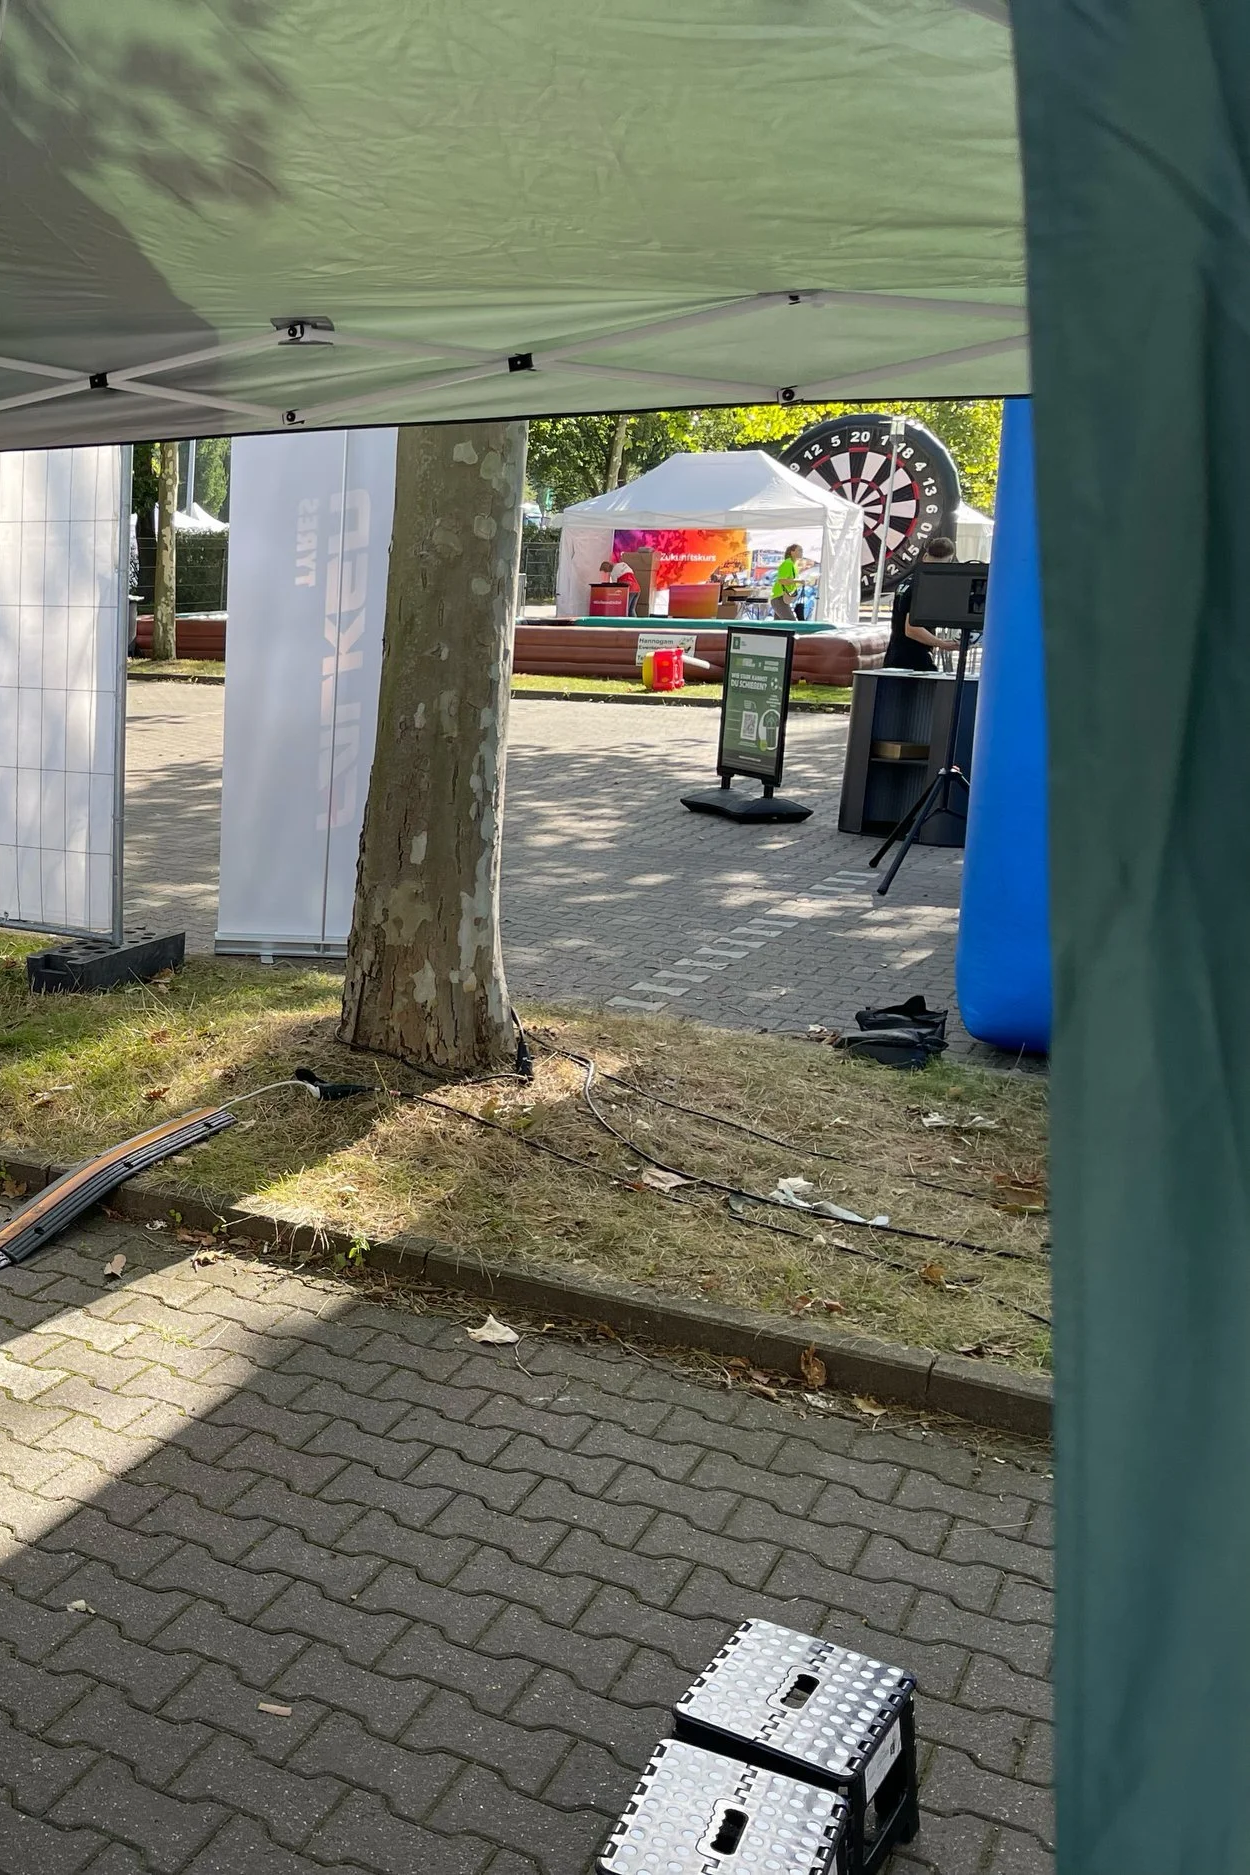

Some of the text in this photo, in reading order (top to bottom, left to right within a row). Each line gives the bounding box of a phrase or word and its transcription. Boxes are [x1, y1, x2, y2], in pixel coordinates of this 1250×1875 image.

[830, 435, 841, 447] 5
[850, 431, 871, 443] 20
[803, 443, 824, 460] 12
[897, 442, 915, 459] 18
[790, 462, 801, 473] 9
[914, 461, 927, 472] 4
[922, 477, 938, 496] 13
[925, 504, 939, 514] 6
[917, 522, 933, 540] 10
[660, 552, 717, 562] Zukunftskurs
[902, 544, 920, 562] 15
[887, 563, 899, 576] 2
